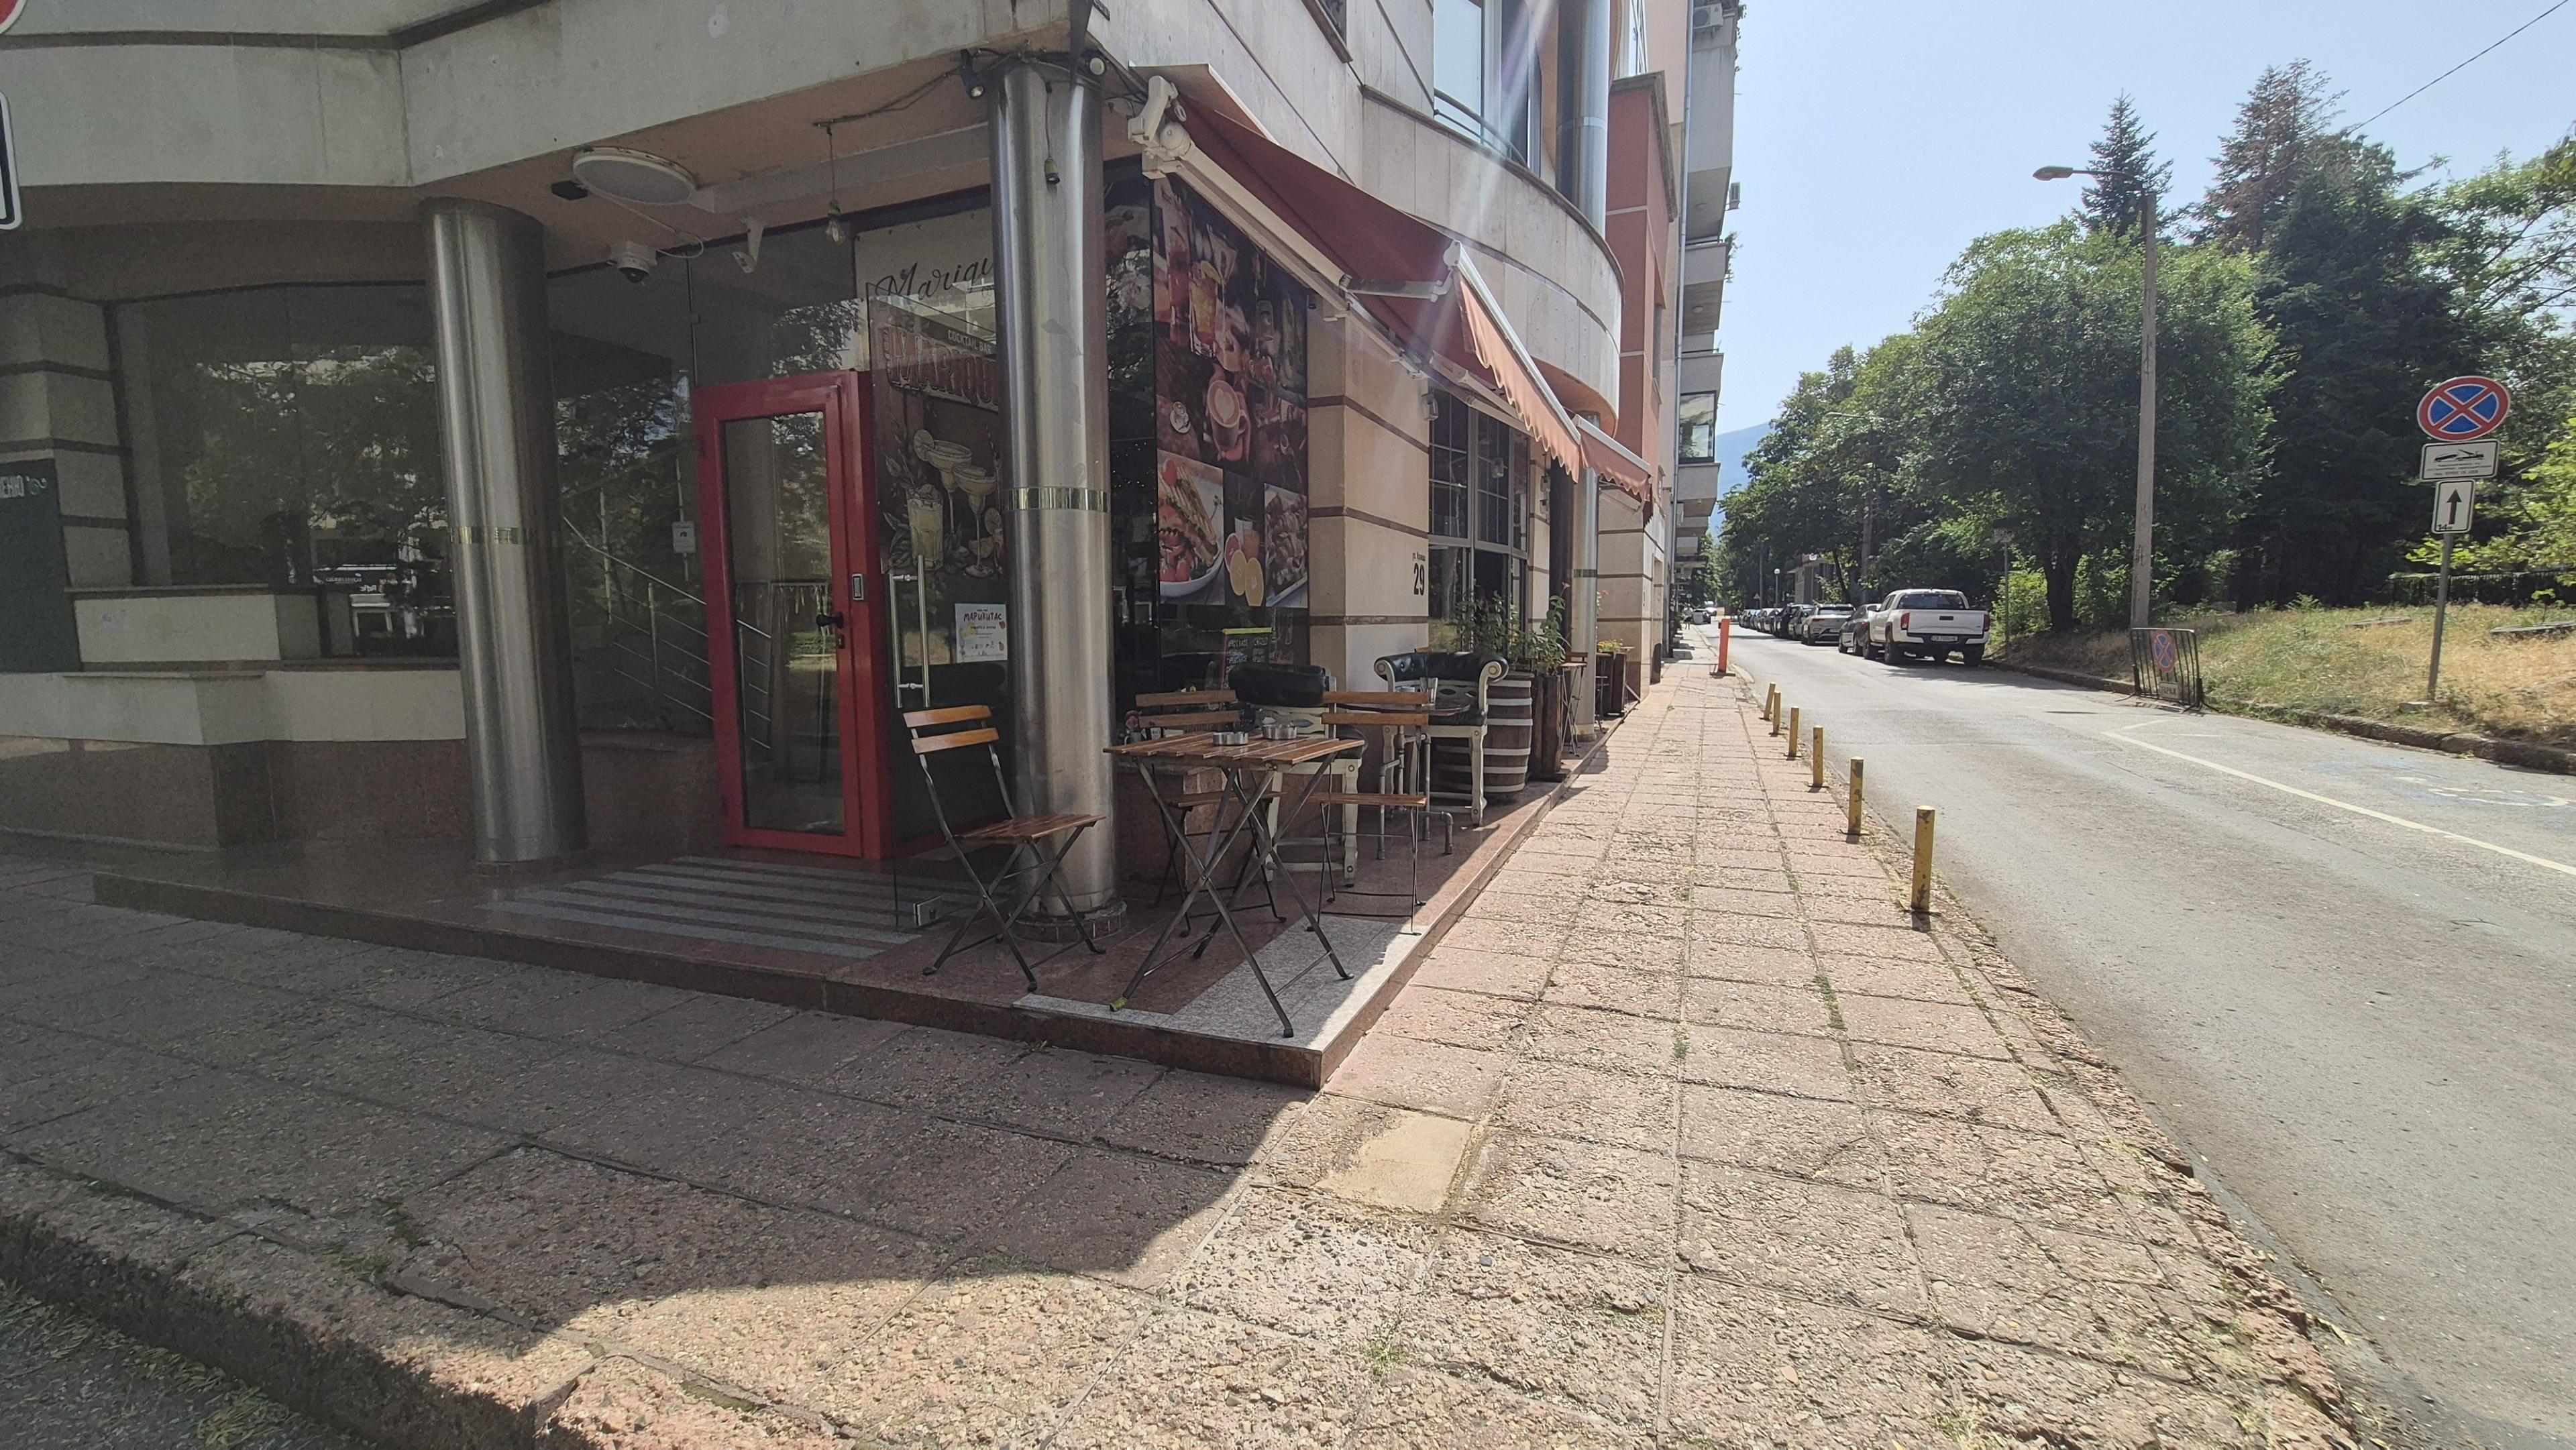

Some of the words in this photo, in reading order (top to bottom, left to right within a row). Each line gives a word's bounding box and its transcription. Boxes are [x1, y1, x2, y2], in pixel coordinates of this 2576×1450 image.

[948, 329, 977, 353] COCKTAIL
[979, 341, 992, 354] BAR
[888, 325, 998, 406] MARIQU
[1413, 563, 1424, 596] 29
